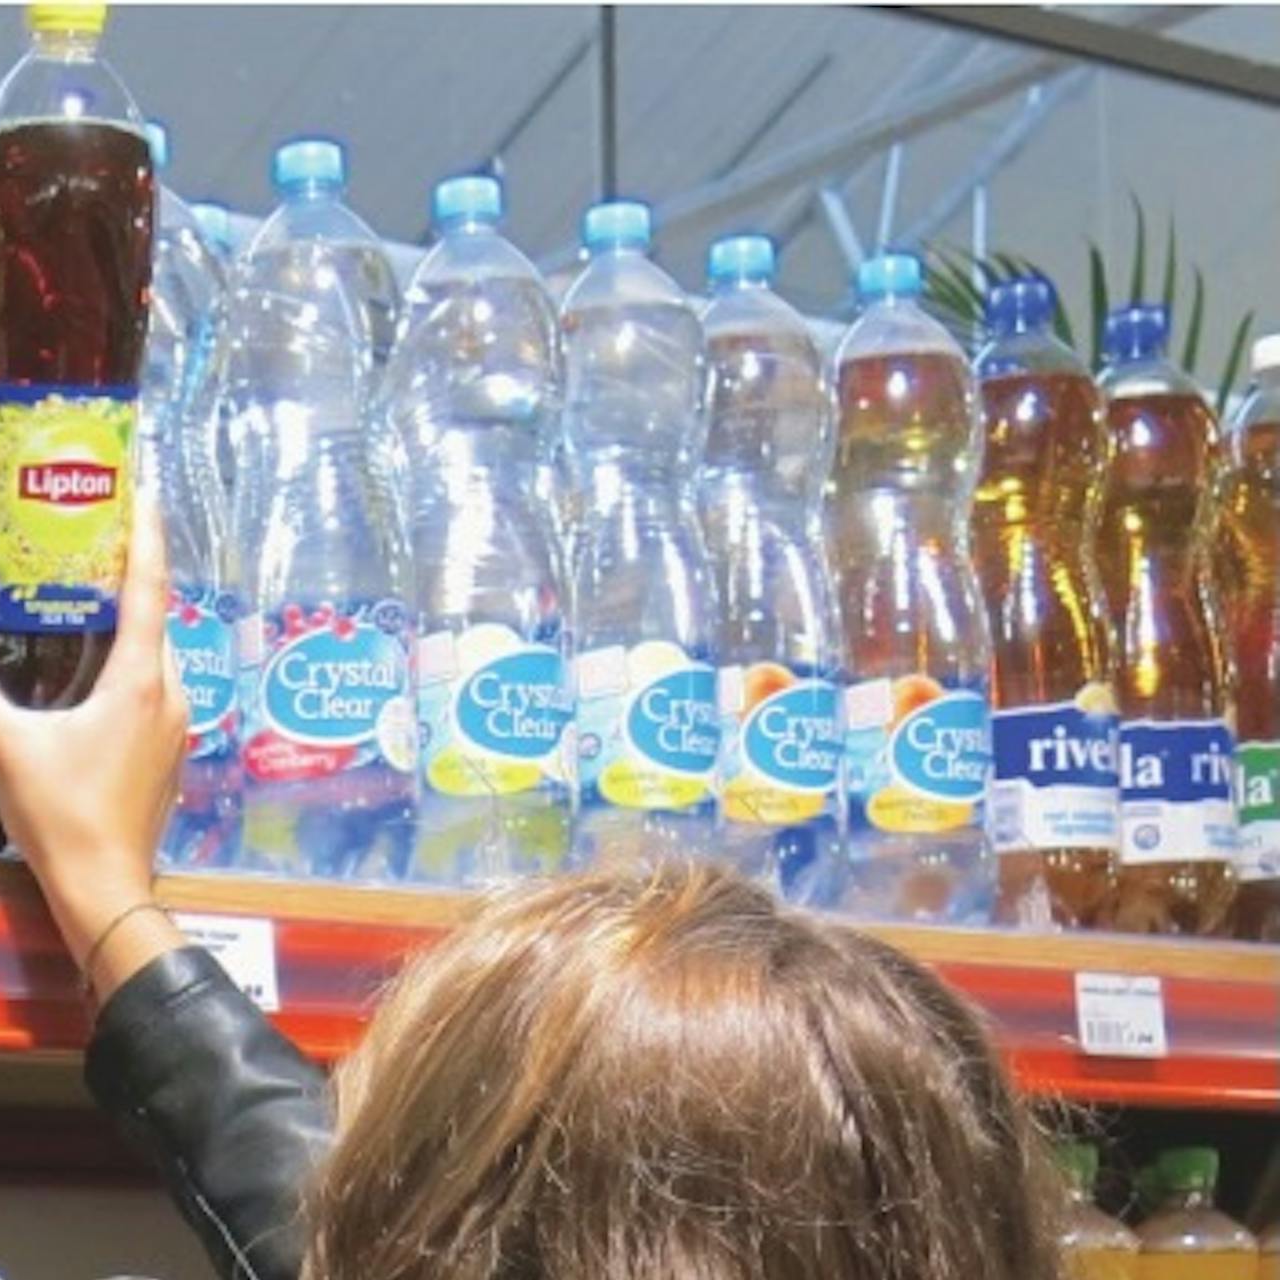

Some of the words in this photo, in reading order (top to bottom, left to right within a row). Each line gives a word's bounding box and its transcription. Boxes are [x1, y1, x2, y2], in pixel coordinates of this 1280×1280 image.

[26, 467, 112, 496] Lipton
[278, 651, 398, 694] Crystal
[293, 687, 374, 720] Clear
